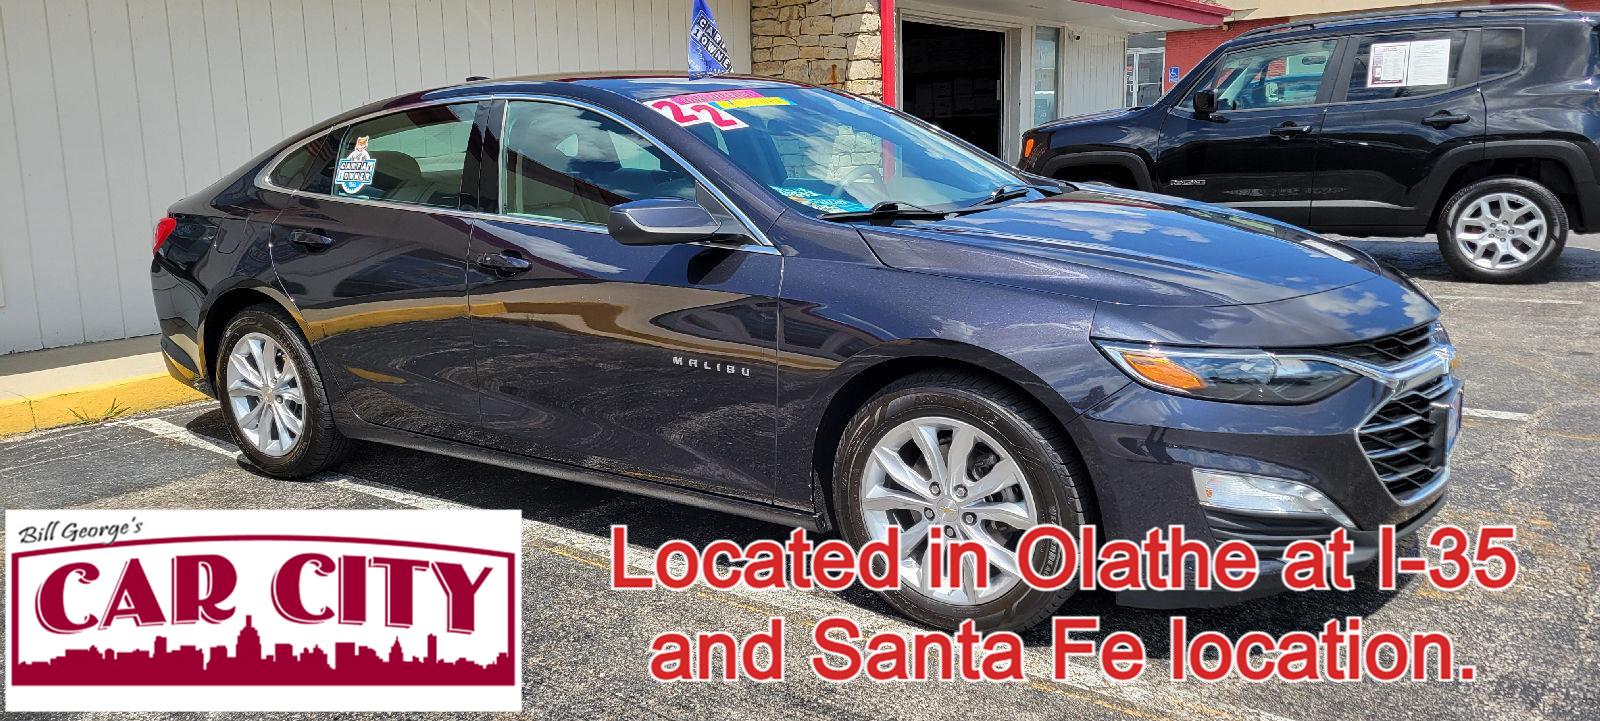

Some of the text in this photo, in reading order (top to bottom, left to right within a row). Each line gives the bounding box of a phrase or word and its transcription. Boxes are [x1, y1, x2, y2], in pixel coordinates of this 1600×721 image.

[651, 100, 738, 127] 22
[343, 171, 371, 181] OWNER
[672, 356, 750, 377] MALIBU
